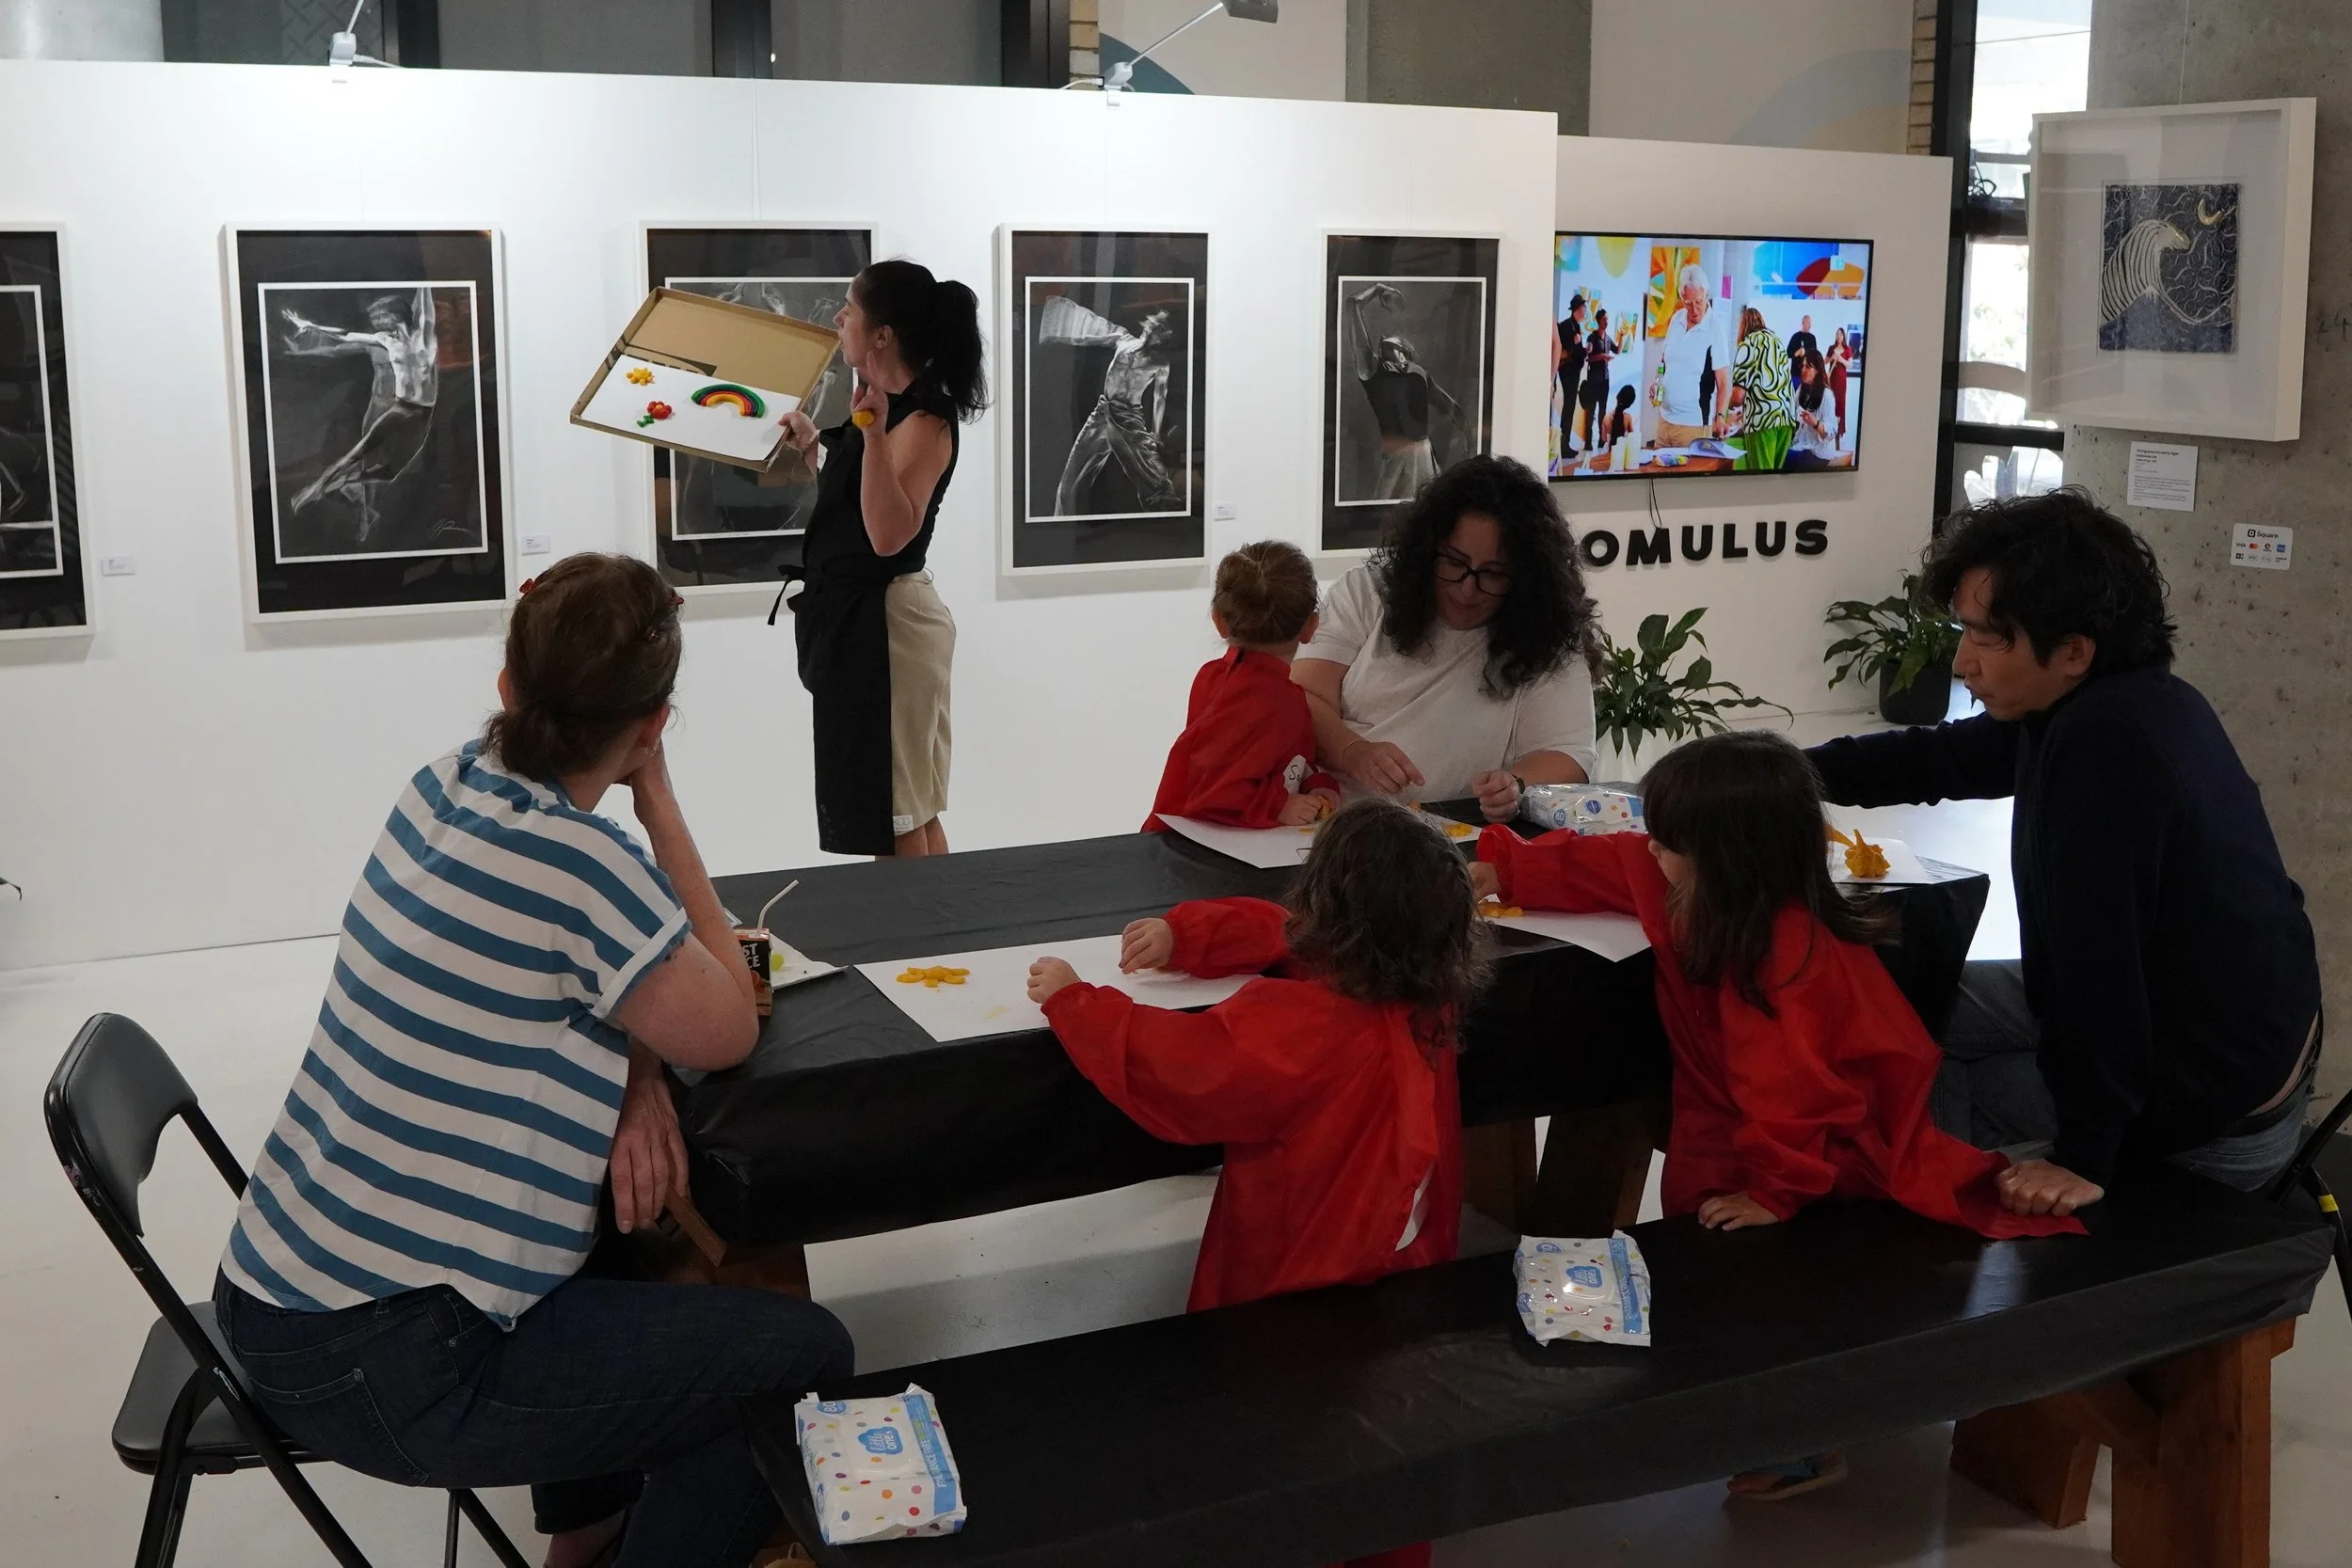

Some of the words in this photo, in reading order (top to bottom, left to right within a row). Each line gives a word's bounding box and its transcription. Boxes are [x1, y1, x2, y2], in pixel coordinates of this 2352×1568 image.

[1581, 519, 1828, 567] OMULUS
[743, 943, 757, 957] ST
[747, 955, 760, 968] CE
